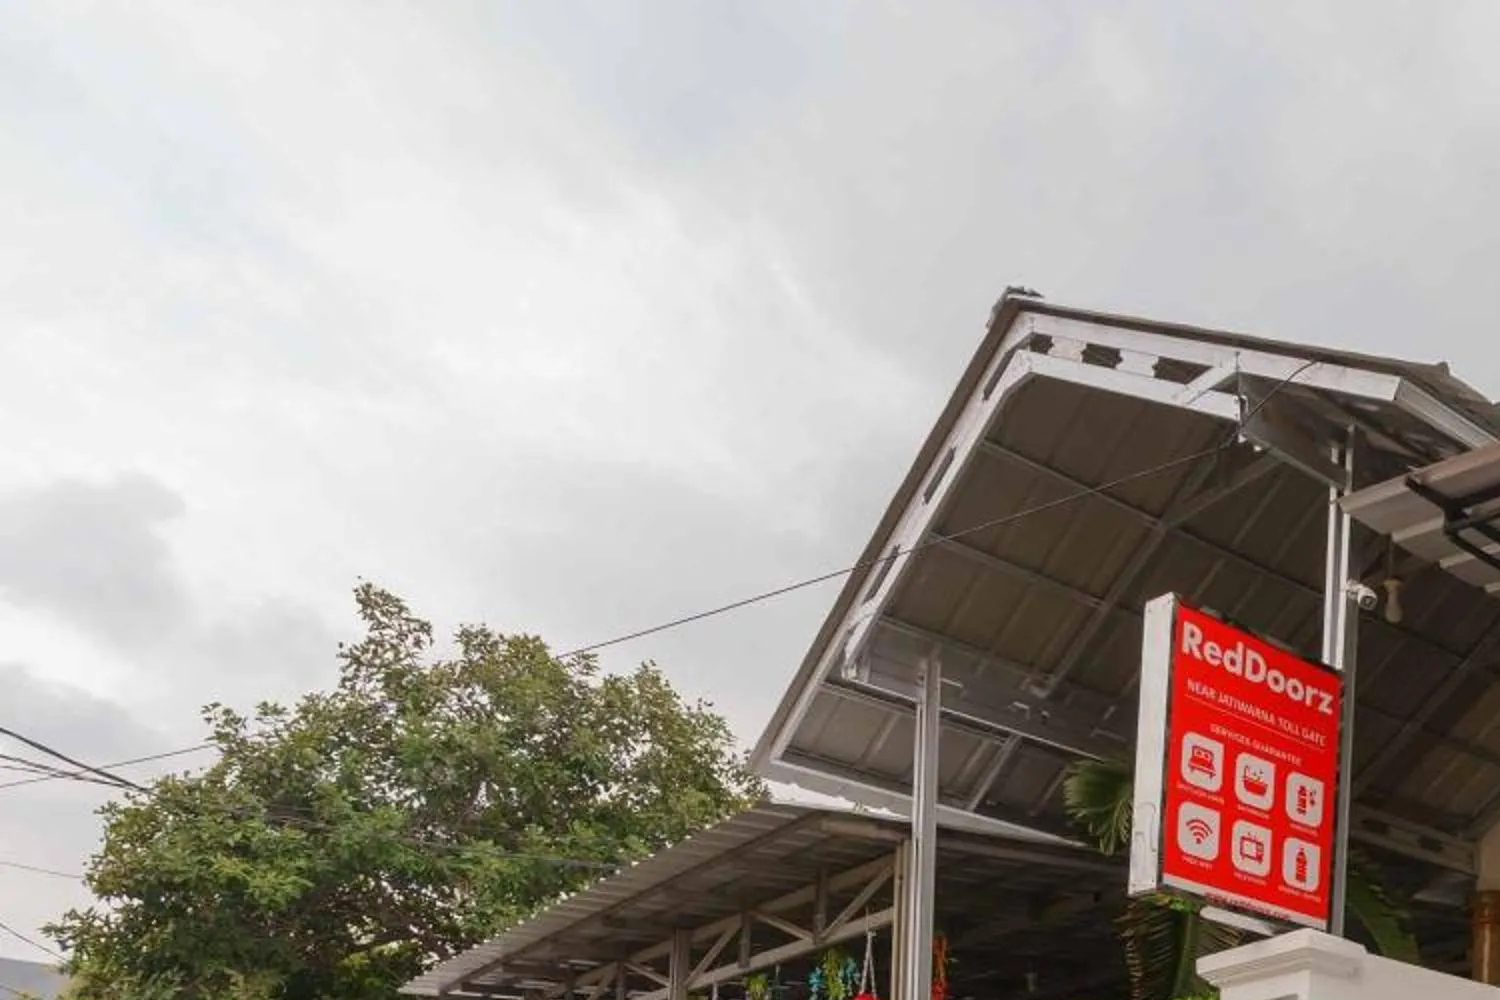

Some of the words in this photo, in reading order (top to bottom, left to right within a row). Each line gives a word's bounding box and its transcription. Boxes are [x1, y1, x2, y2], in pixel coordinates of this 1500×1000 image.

[1182, 620, 1334, 715] RedDoorz
[1187, 679, 1216, 701] NEAR
[1301, 726, 1327, 747] GATE
